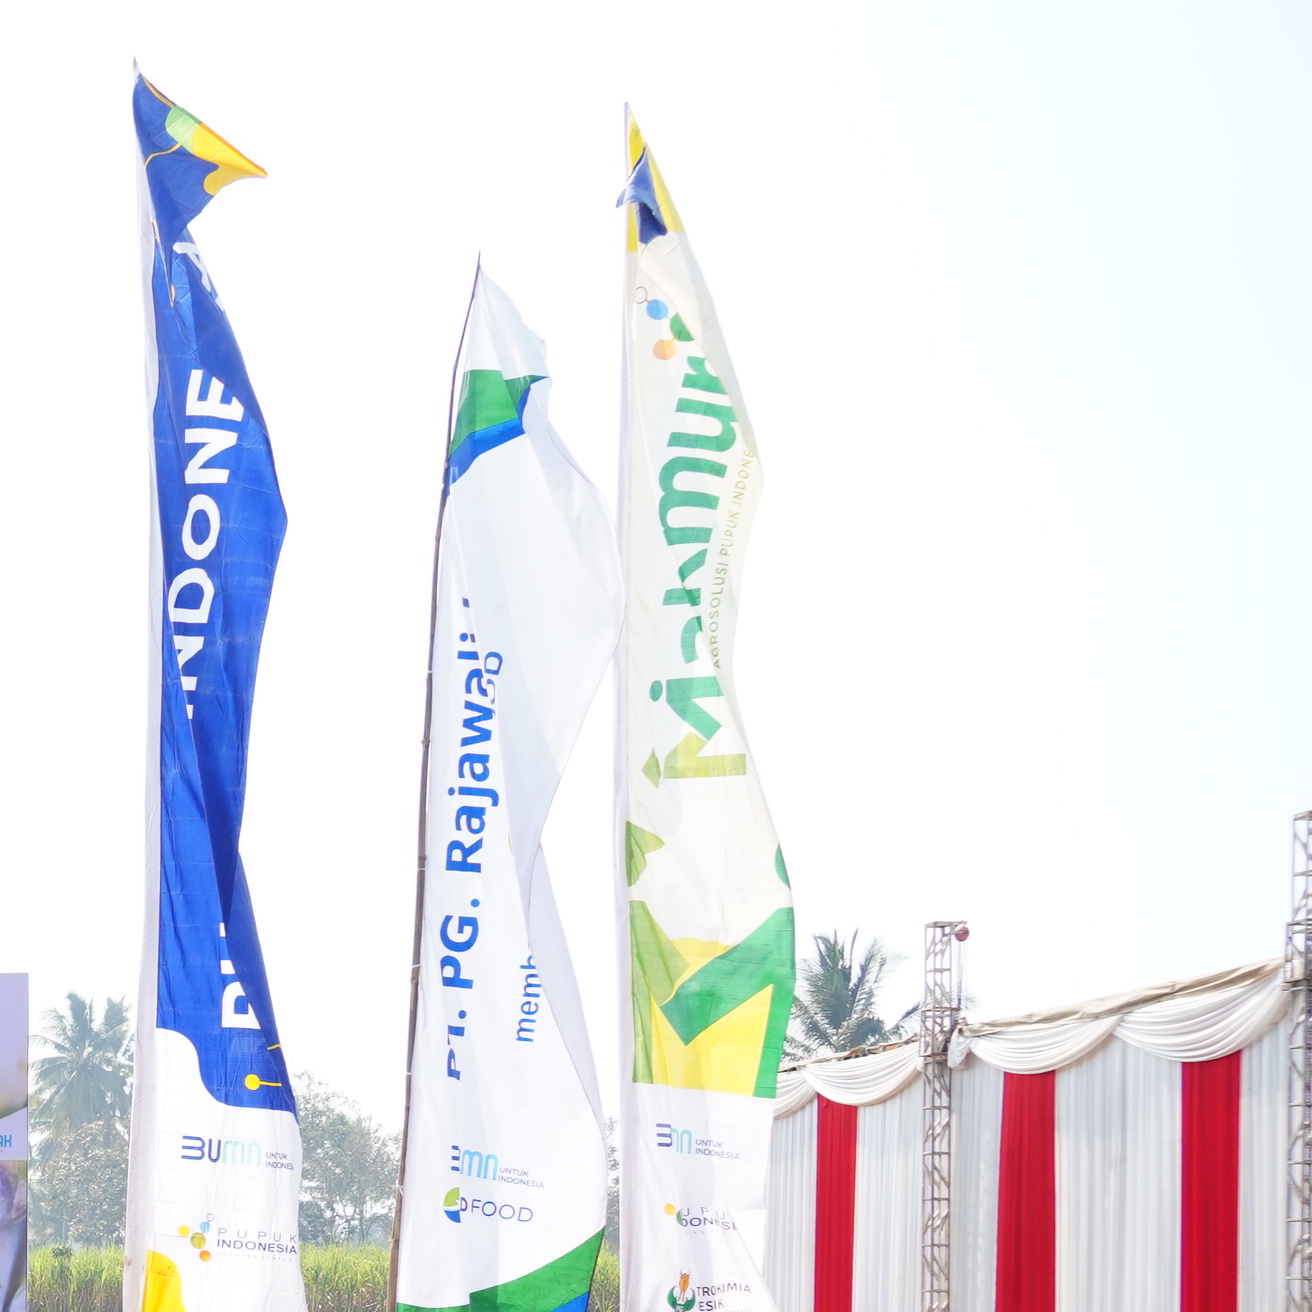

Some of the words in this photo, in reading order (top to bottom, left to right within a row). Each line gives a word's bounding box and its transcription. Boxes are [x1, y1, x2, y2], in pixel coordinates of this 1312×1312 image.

[708, 563, 729, 669] AGROSOLUSI
[719, 511, 740, 556] PUPUK
[439, 897, 480, 990] PG.
[695, 1138, 723, 1149] UNTUK
[695, 1147, 741, 1160] INDONESIA
[499, 1166, 529, 1177] UNTUK
[497, 1174, 544, 1189] INDONESIA
[471, 1198, 534, 1222] FOOD
[217, 1227, 297, 1244] PUPUK
[217, 1239, 297, 1254] INDONESIA
[696, 1282, 752, 1298] TROKIMIA
[698, 1299, 725, 1312] ESIK
